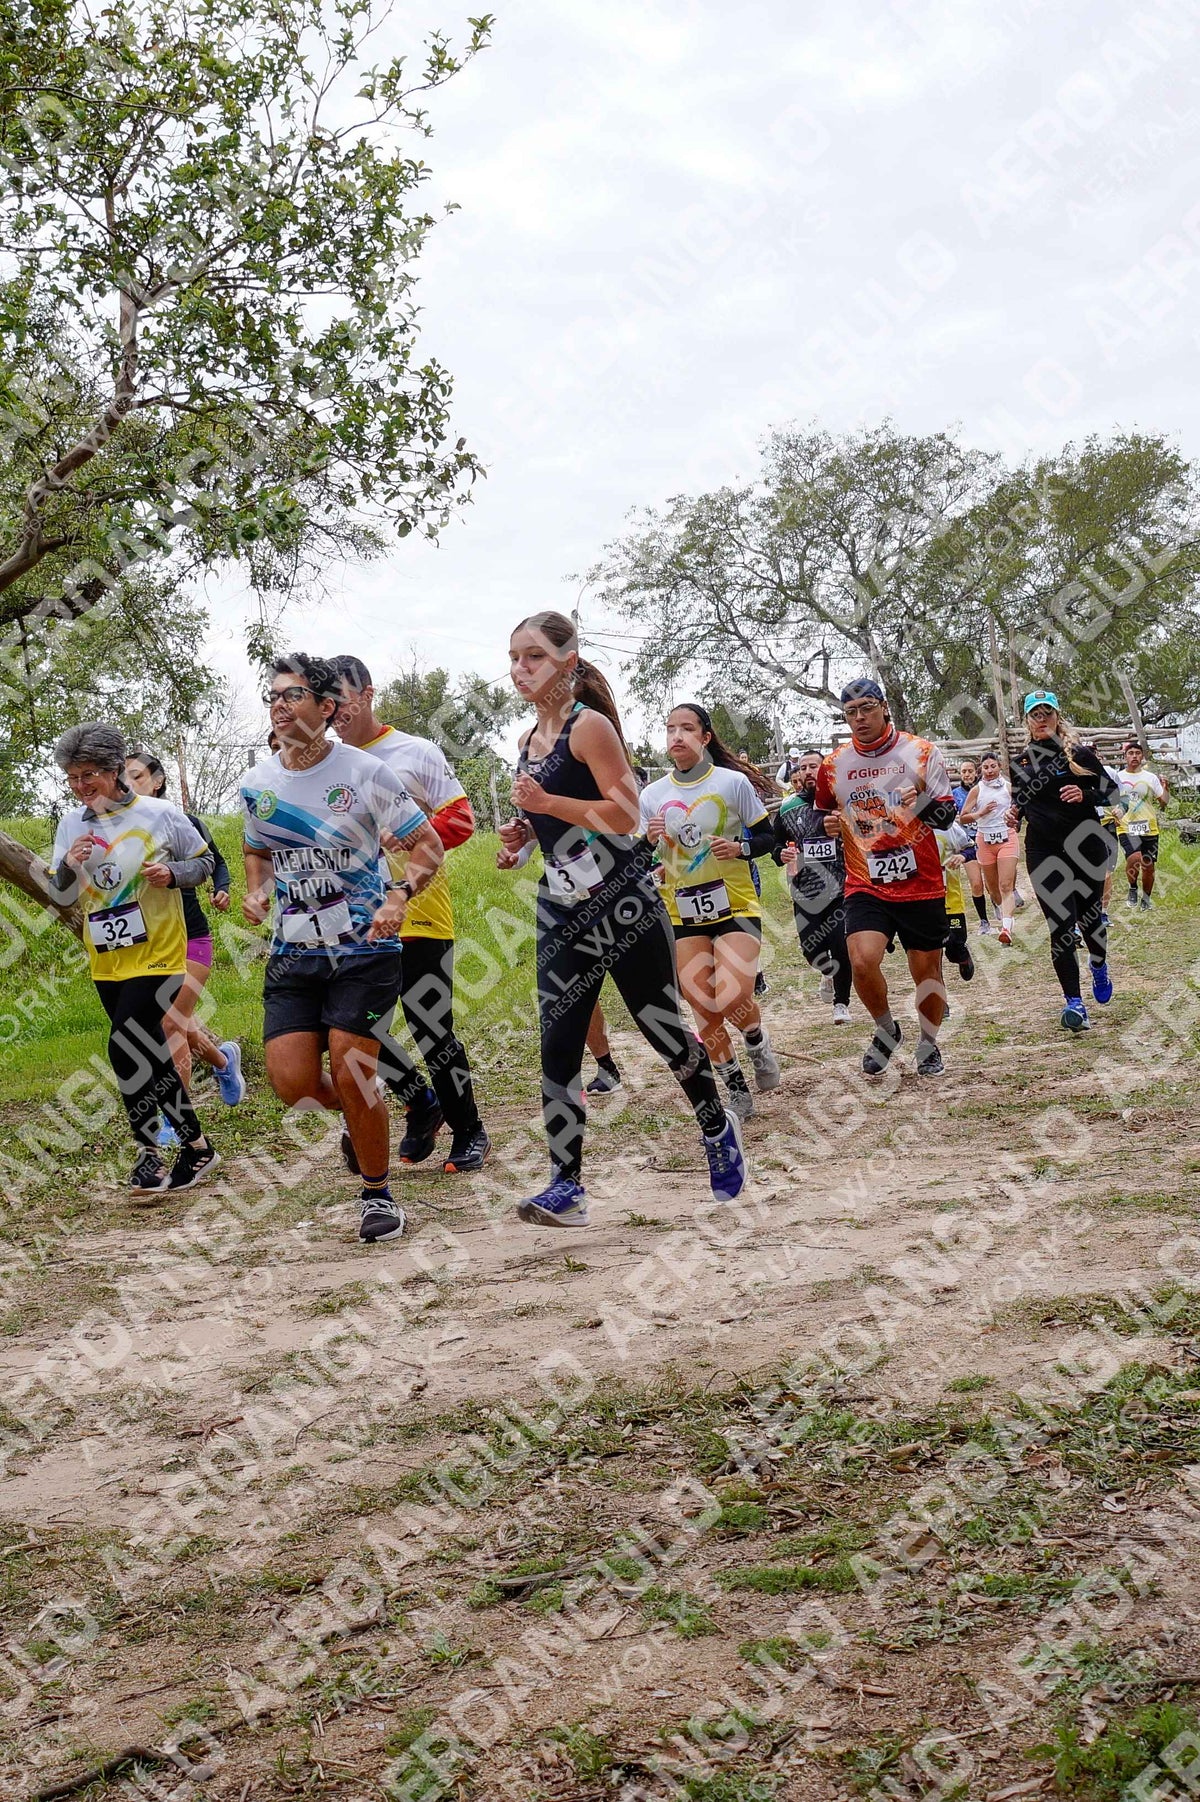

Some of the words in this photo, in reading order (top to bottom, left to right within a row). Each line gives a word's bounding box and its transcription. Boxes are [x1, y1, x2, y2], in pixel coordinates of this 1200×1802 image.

[858, 765, 905, 779] Gigared
[990, 832, 1002, 841] 94
[1131, 824, 1147, 833] 409
[808, 844, 832, 857] 448
[875, 856, 911, 877] 242
[557, 869, 576, 893] 3
[691, 894, 715, 915] 15
[102, 918, 131, 942] 32
[309, 914, 321, 937] 1
